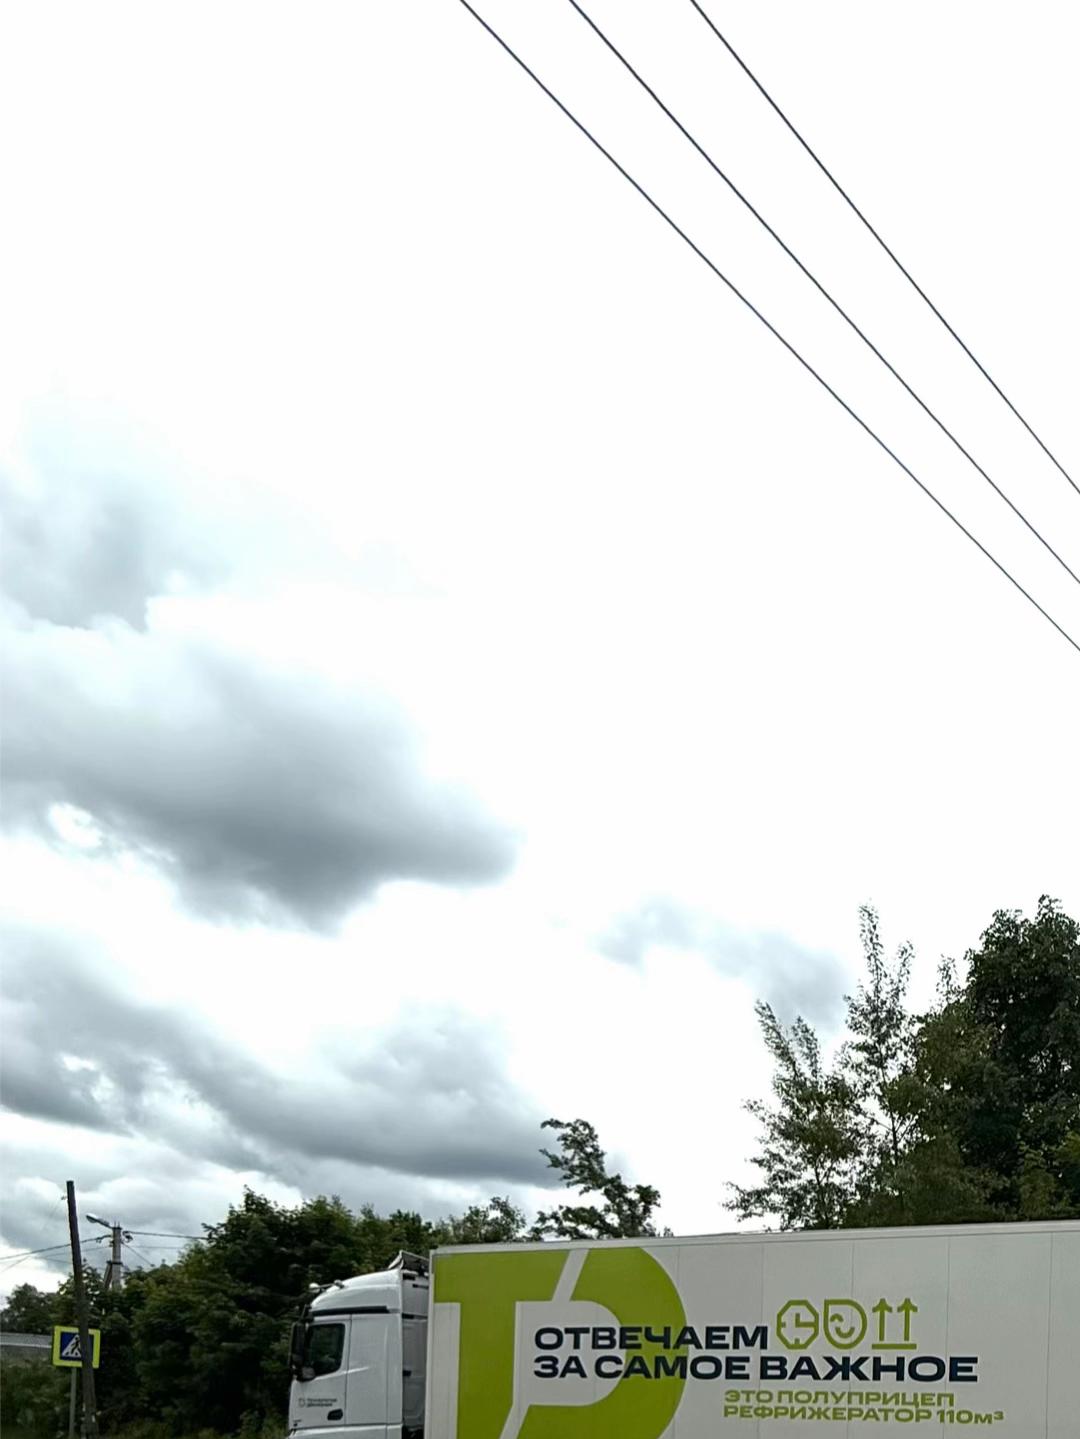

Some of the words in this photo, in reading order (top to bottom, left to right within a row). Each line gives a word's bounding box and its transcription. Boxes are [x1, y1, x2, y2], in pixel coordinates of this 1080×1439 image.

[534, 1325, 768, 1350] ОТВЕЧАЕМ
[533, 1355, 588, 1379] ЗА
[594, 1356, 750, 1380] САМОЕ
[759, 1356, 979, 1382] ВАЖНОЕ
[724, 1390, 774, 1404] ЭТО
[777, 1390, 955, 1407] ПОЛУПРИЦЕП
[723, 1405, 932, 1423] РЕФРИЖЕРАТОР
